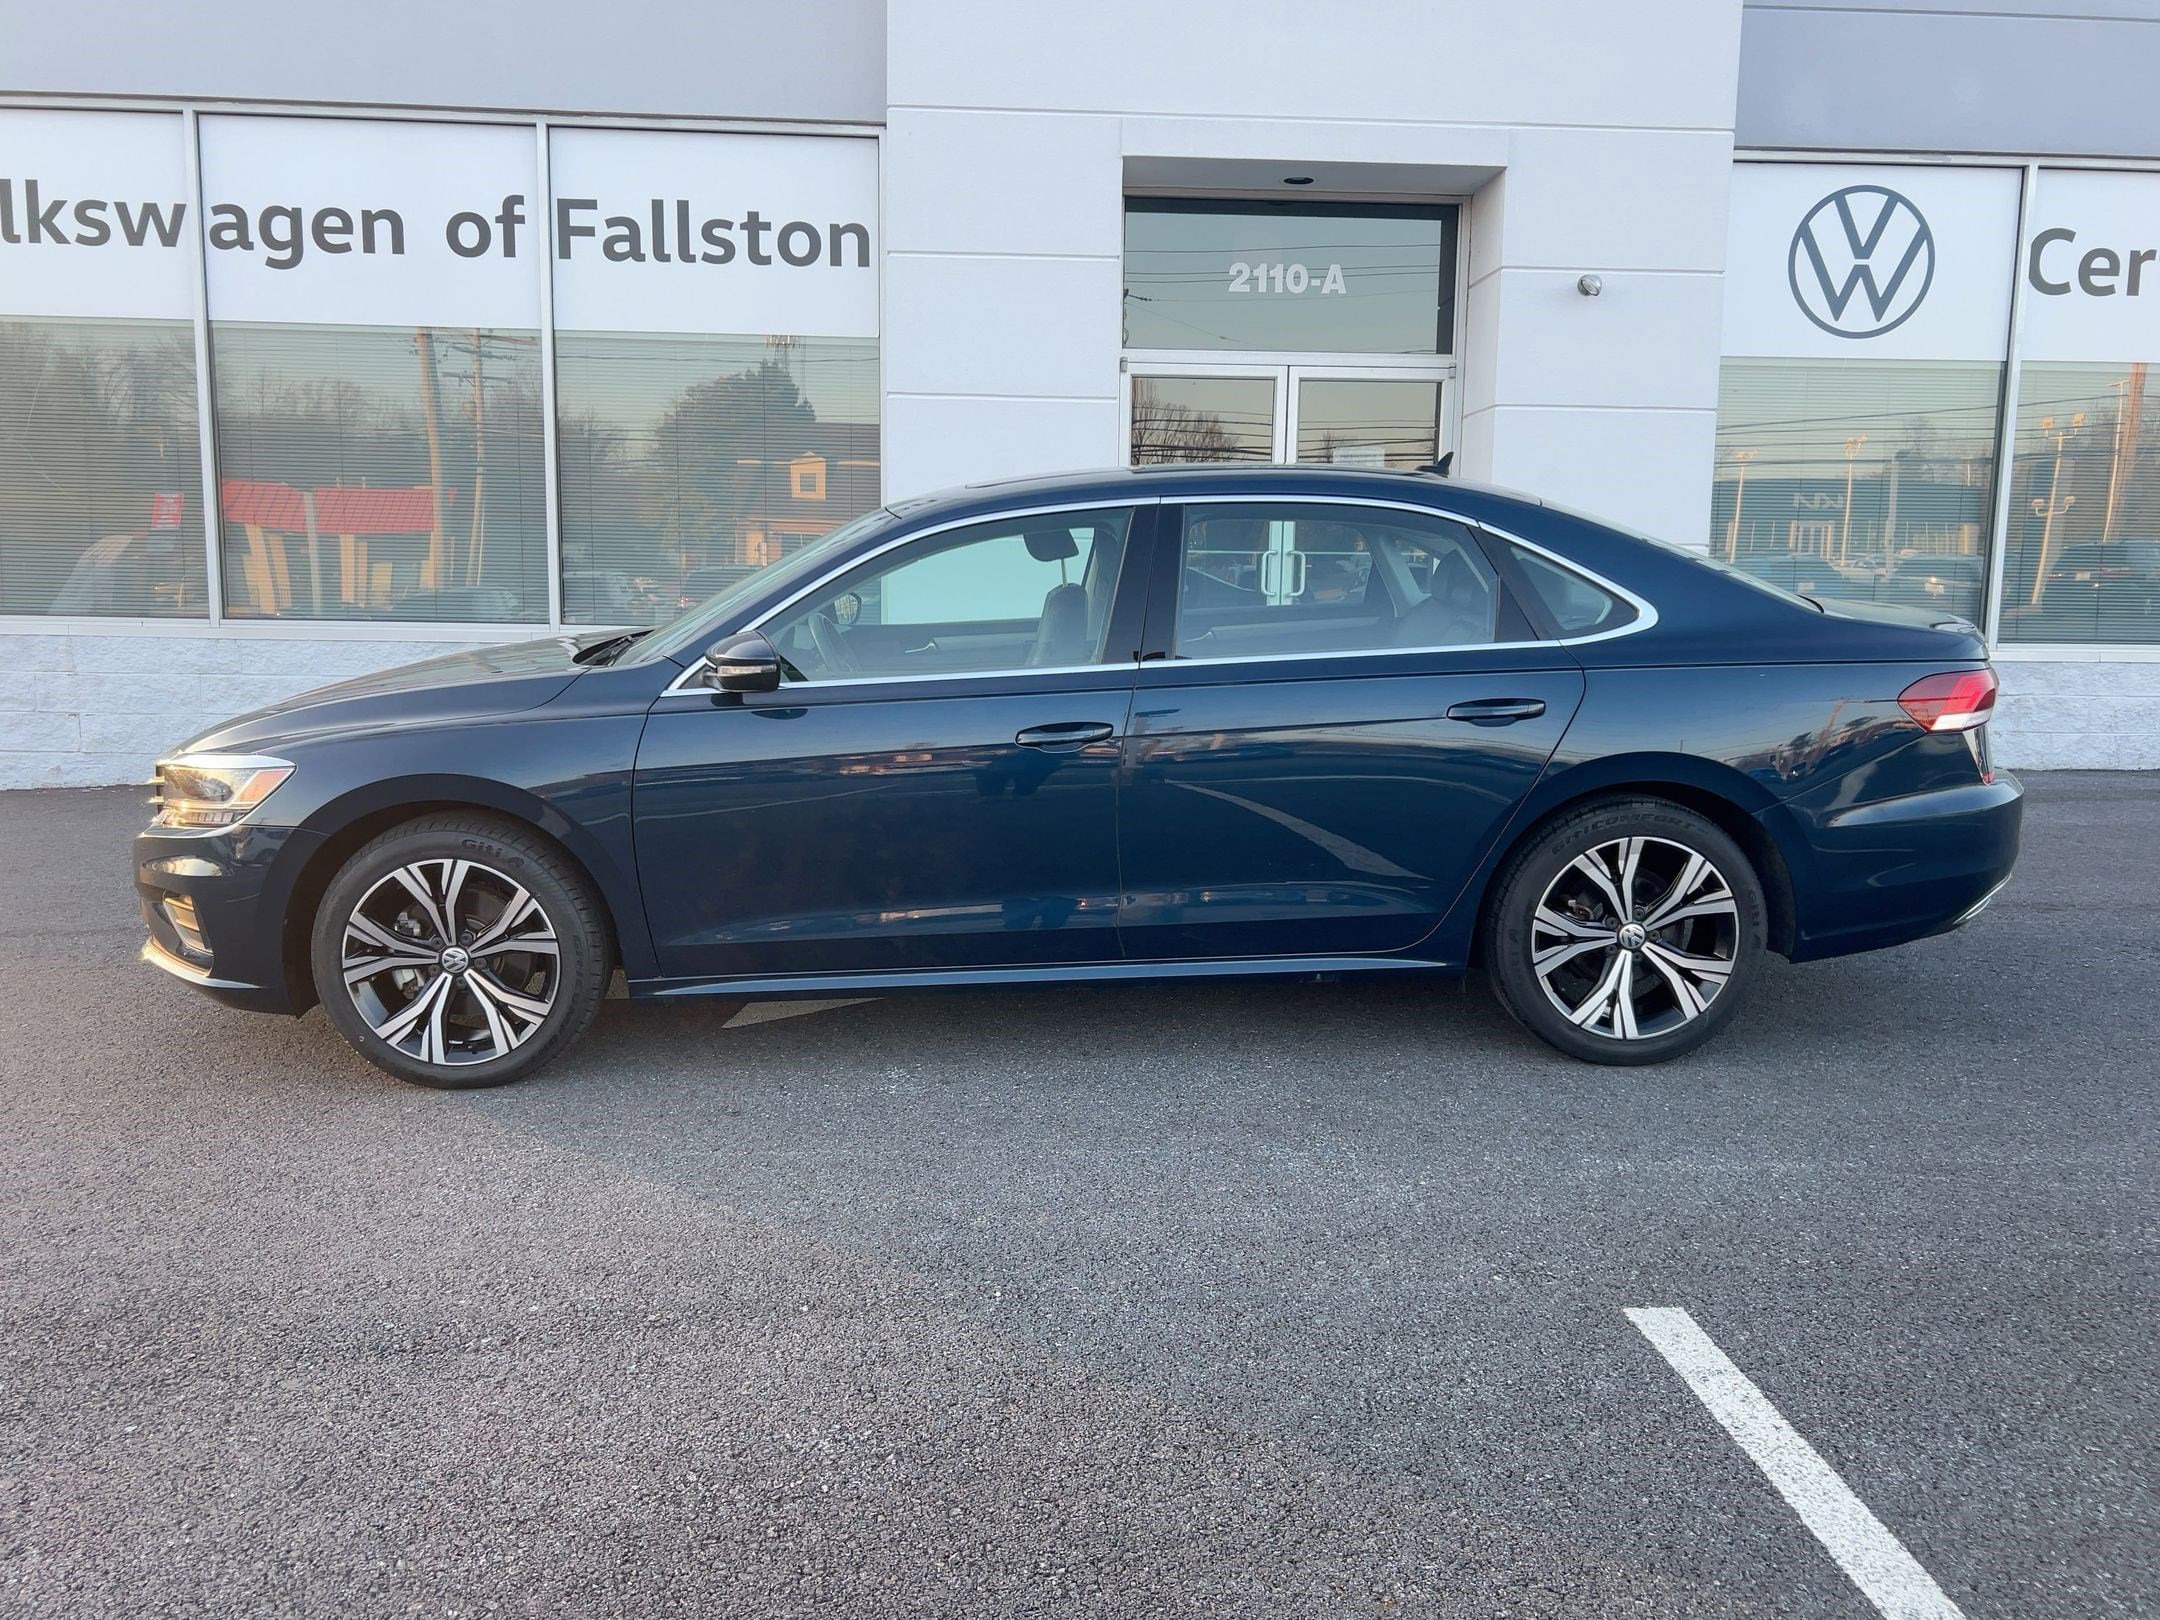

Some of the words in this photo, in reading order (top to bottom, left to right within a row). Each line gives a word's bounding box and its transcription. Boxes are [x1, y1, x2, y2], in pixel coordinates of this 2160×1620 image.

[445, 194, 526, 258] of
[556, 198, 871, 268] Fallston
[1788, 185, 1936, 339] VW
[1228, 262, 1347, 294] 2110-A
